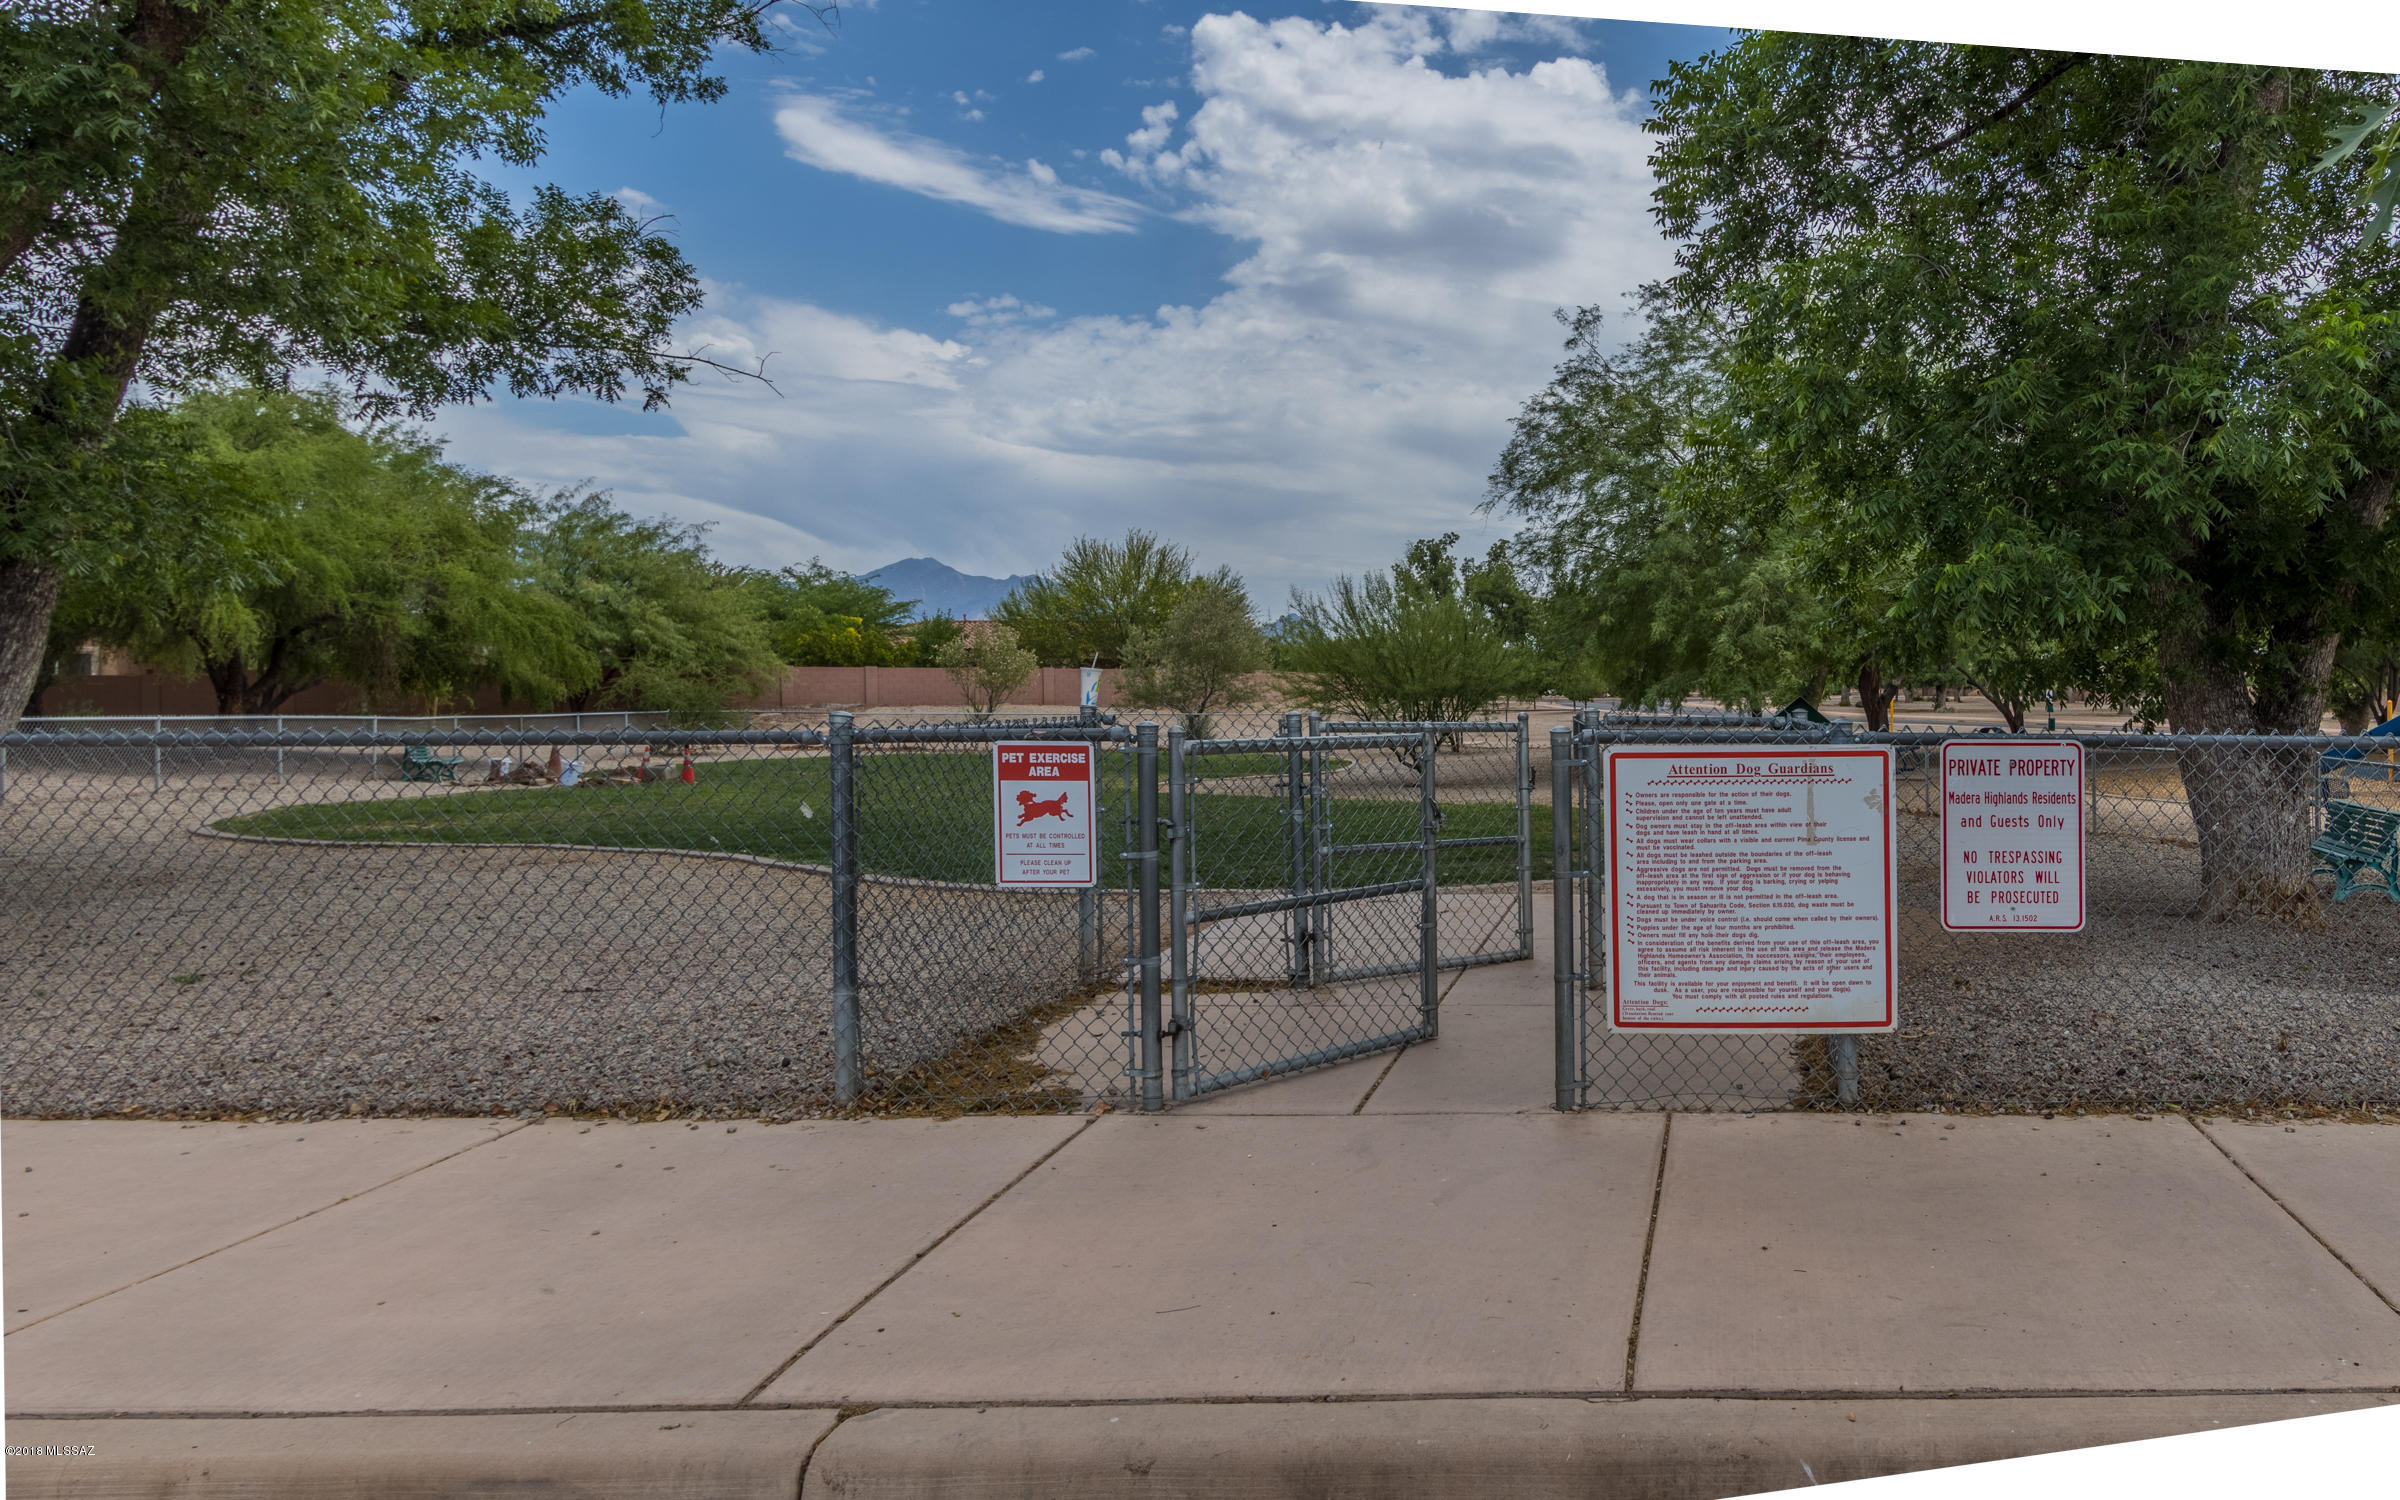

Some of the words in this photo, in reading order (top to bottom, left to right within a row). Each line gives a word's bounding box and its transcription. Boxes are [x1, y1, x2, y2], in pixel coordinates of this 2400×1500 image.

[1001, 752, 1024, 763] PET
[1029, 753, 1086, 763] EXERCISE
[1028, 766, 1060, 777] AREA
[1668, 762, 1728, 775] Attention
[1736, 762, 1761, 778] Dog
[1768, 762, 1834, 774] Guardians
[1949, 759, 2001, 776] PRIVATE
[2009, 759, 2076, 776] PROPERTY
[1948, 792, 1981, 805] Madera
[1984, 792, 2028, 807] Highlands
[2032, 792, 2077, 805] Residents
[1960, 815, 1982, 828] and
[1990, 815, 2030, 828] Guests
[2038, 815, 2064, 830] Only
[1963, 850, 1978, 864] NO
[1988, 850, 2062, 864] TRESPASSING
[1966, 871, 2024, 884] VIOLATORS
[2035, 871, 2060, 884] WILL
[1967, 891, 1980, 904] BE
[1991, 891, 2059, 904] PROSECUTED
